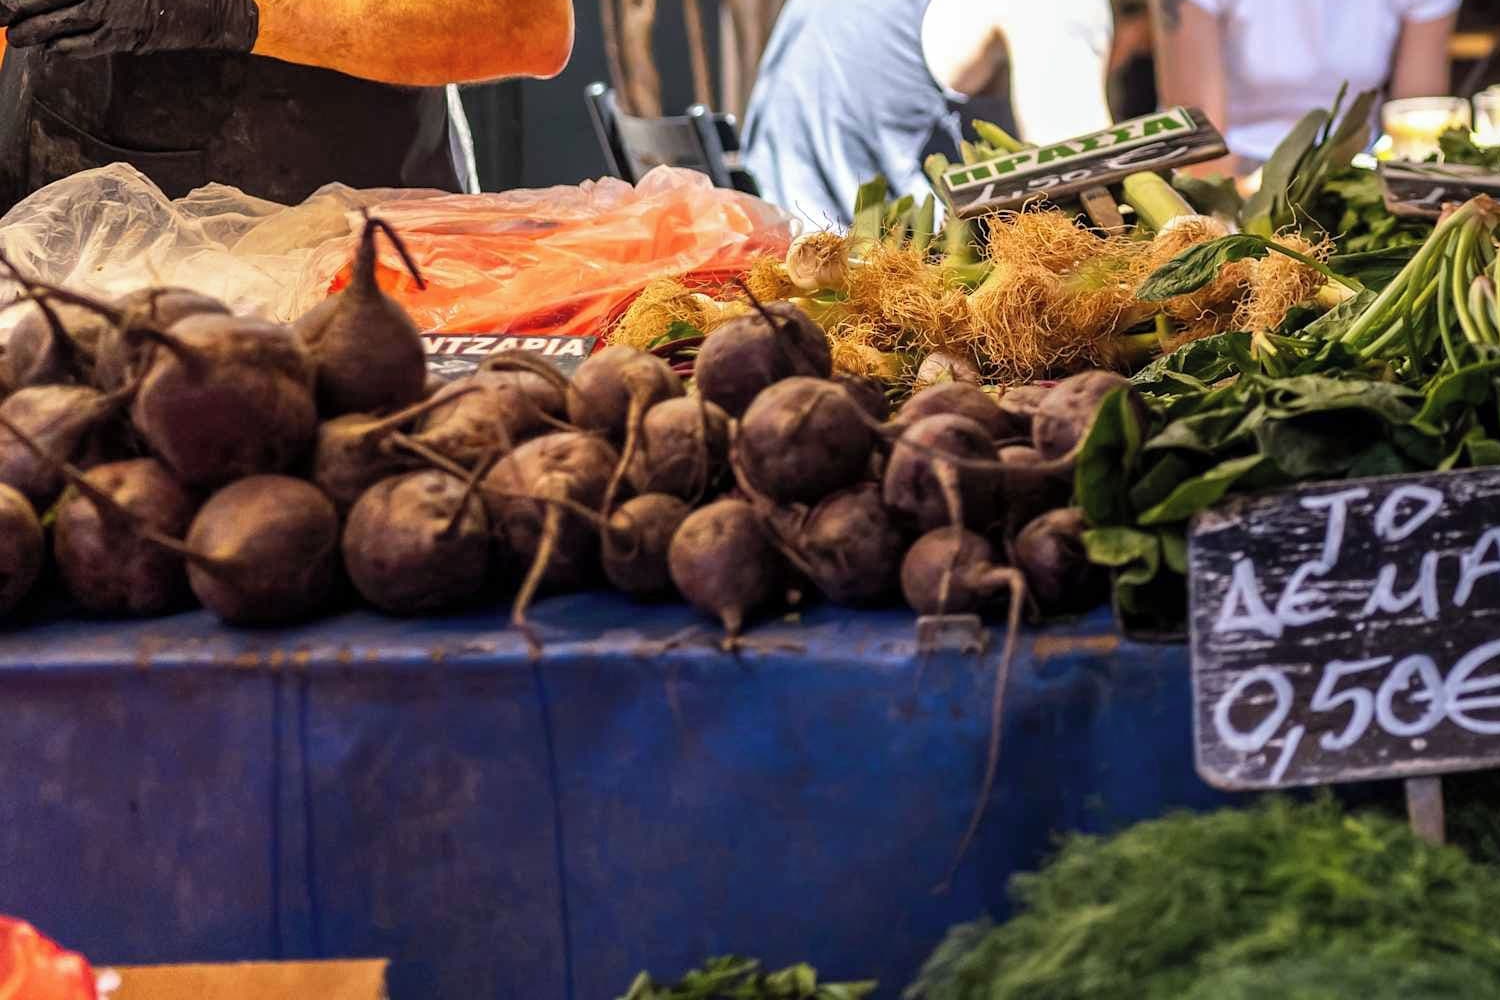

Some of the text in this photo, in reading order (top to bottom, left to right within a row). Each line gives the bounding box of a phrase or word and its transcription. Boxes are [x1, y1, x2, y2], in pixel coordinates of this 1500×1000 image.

[950, 115, 1184, 184] ΠΡΑΣΣΑ
[422, 336, 585, 356] ΝΤΖΑΡΙΑ
[1301, 485, 1444, 574] ΤΟ
